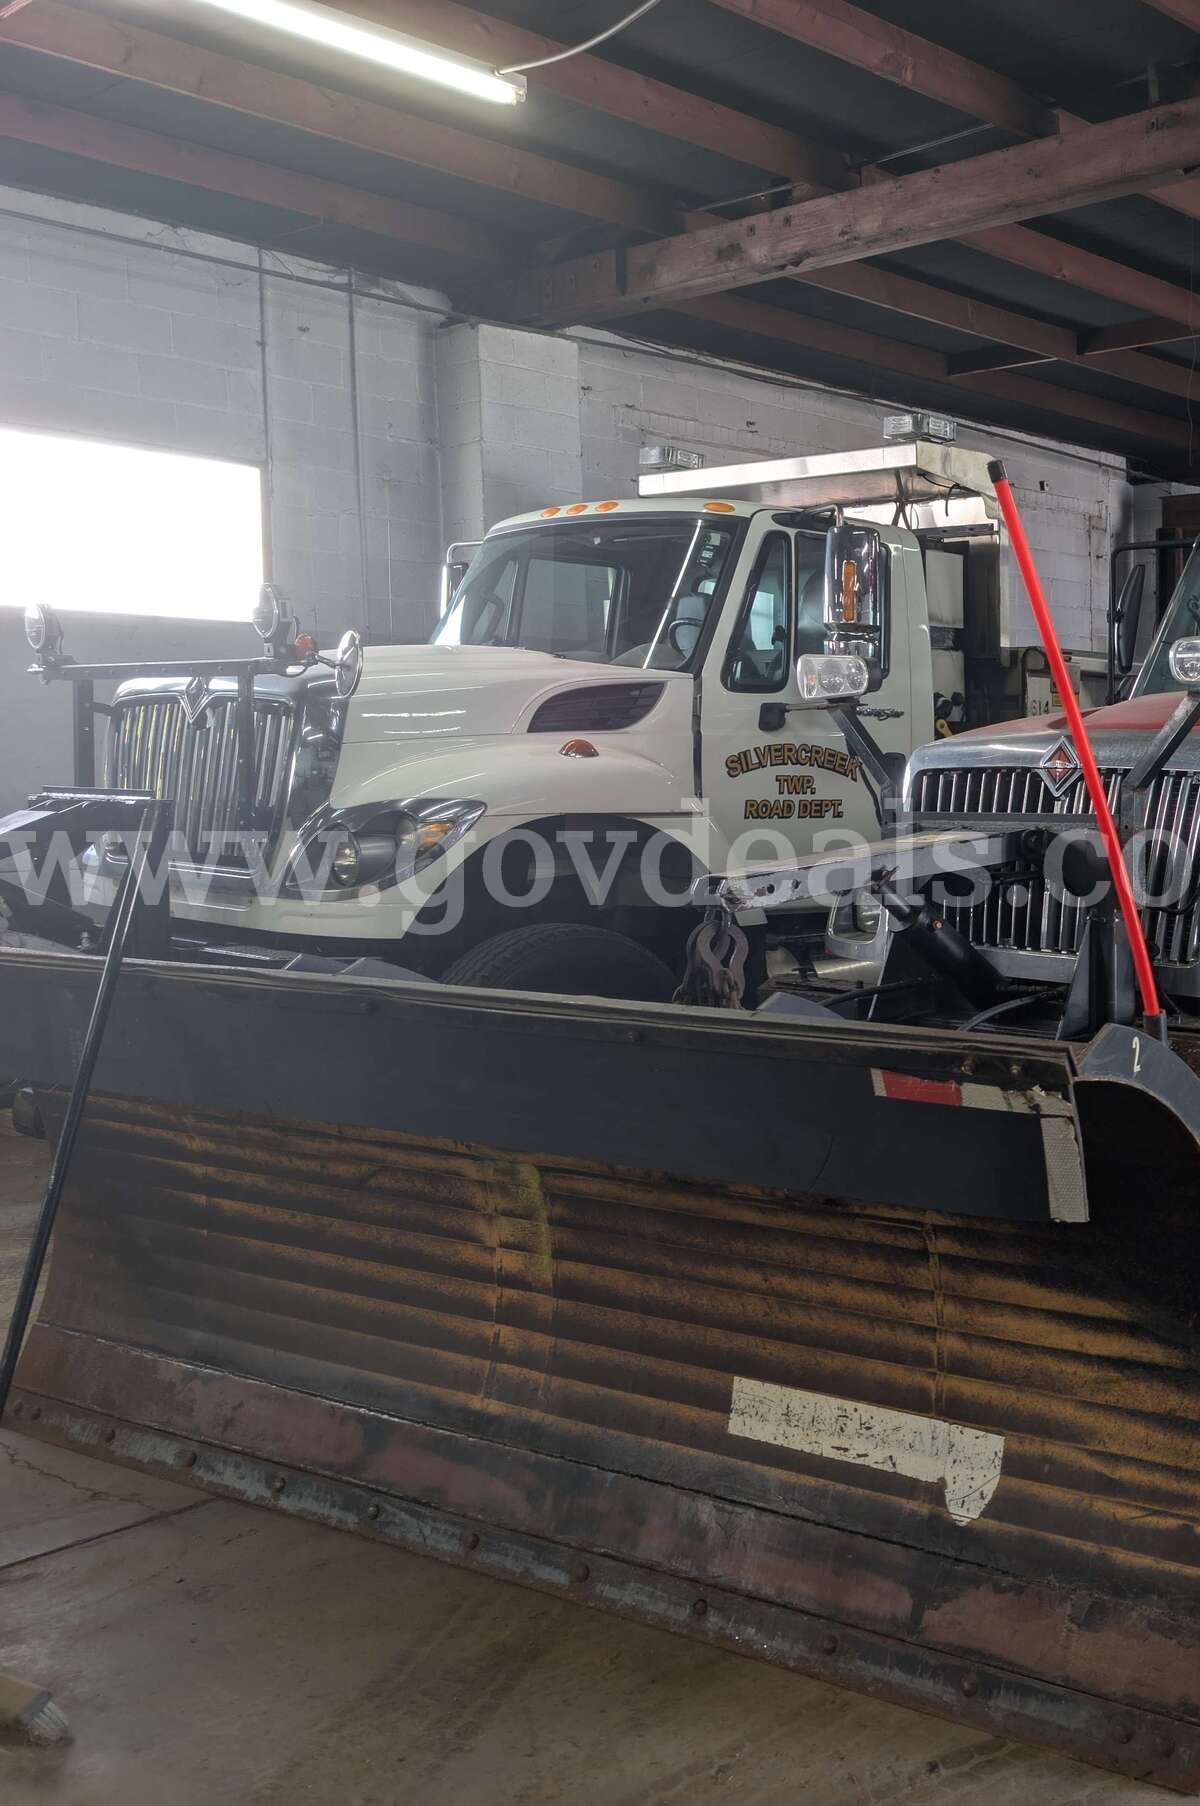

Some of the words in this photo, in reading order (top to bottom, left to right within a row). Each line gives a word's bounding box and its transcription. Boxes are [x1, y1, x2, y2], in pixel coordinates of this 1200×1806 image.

[725, 743, 861, 782] SILVERCREEK
[775, 775, 816, 795] TWP.
[744, 799, 796, 819] ROAD
[797, 799, 844, 819] DEPT.
